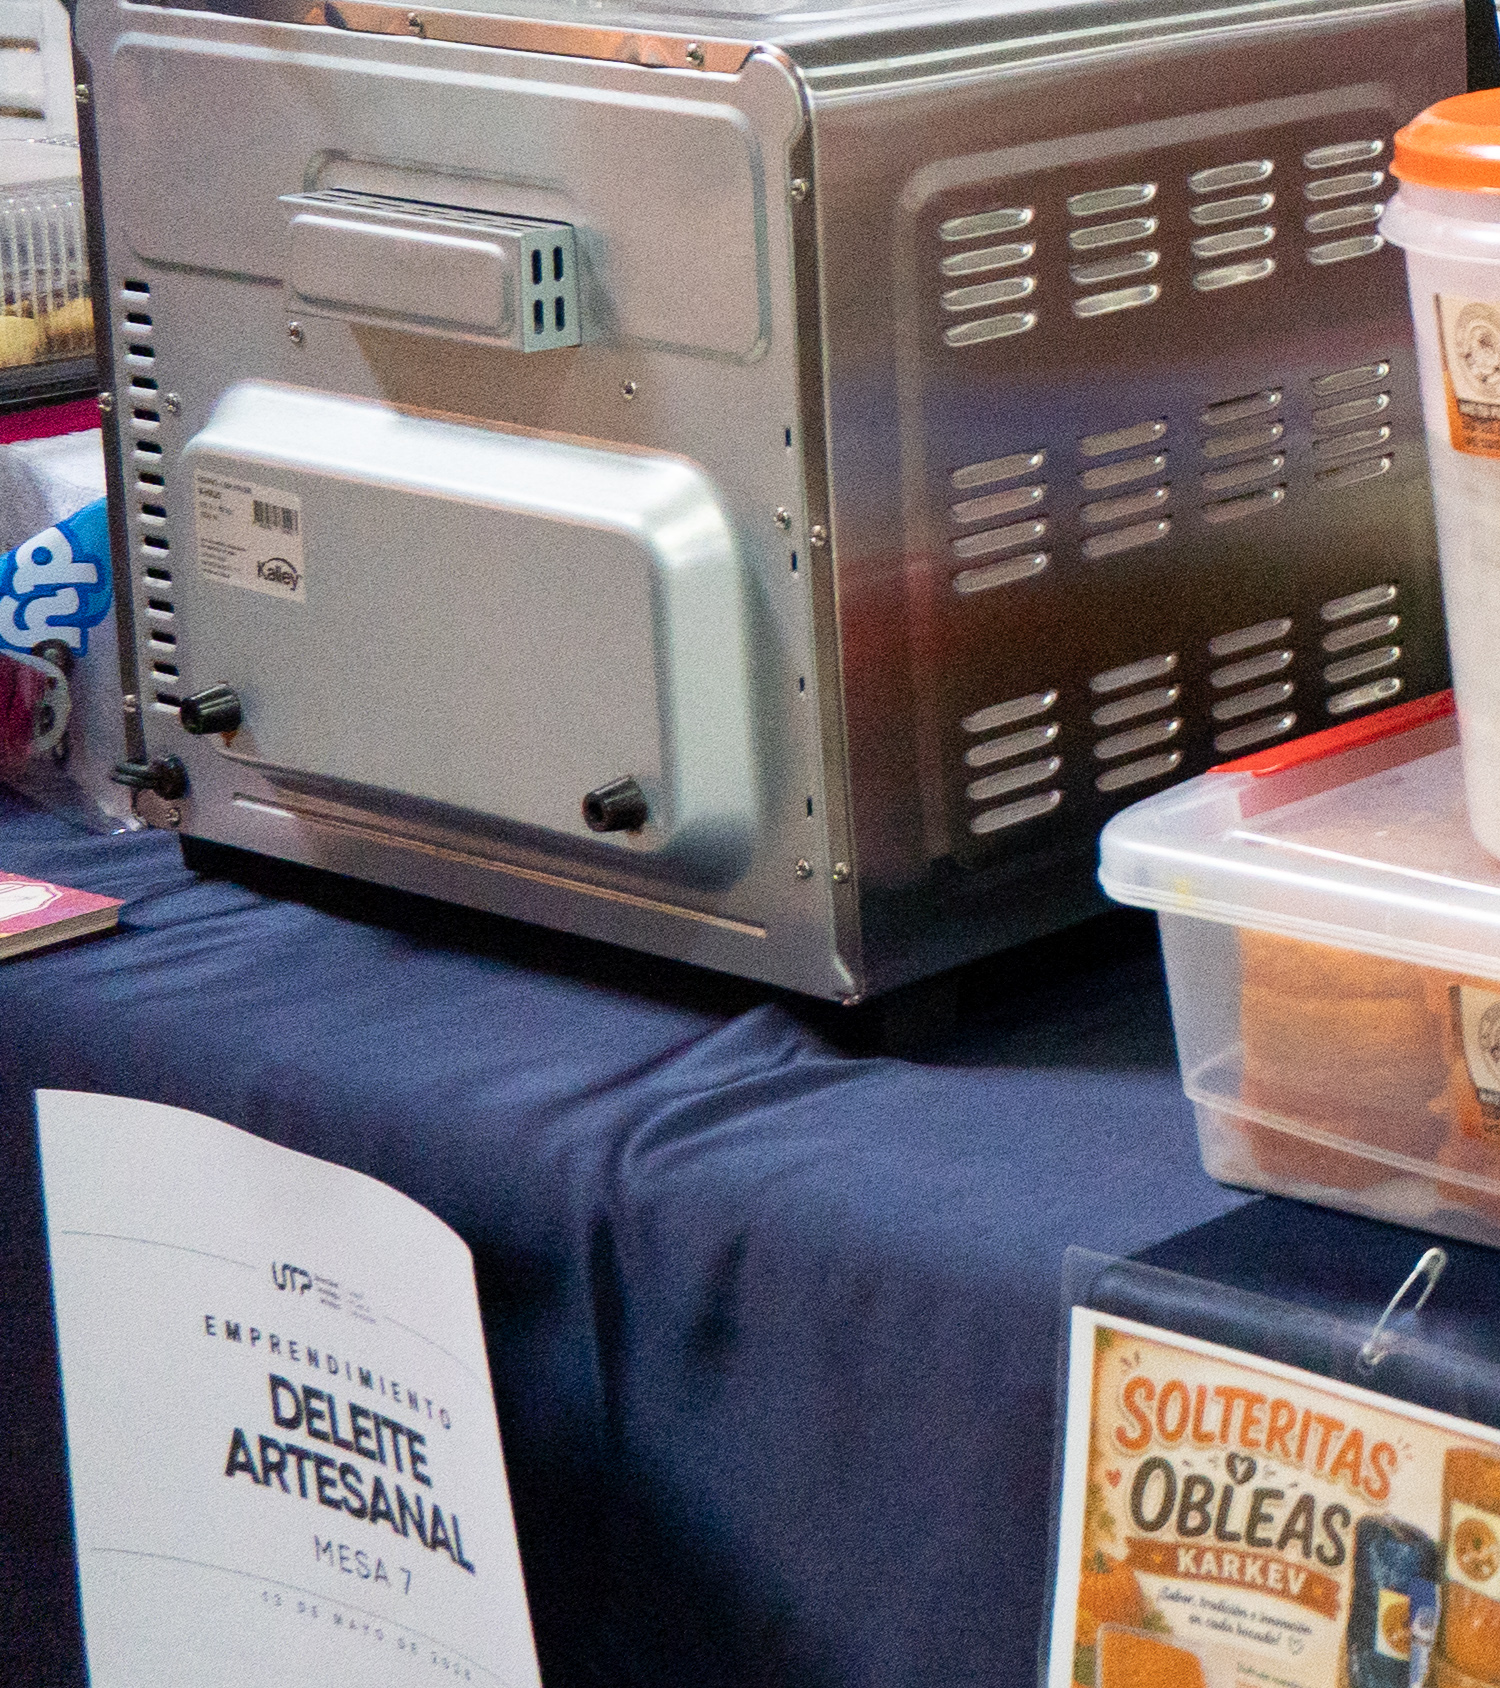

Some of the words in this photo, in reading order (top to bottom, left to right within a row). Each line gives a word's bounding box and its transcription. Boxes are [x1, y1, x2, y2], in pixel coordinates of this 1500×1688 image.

[204, 1315, 453, 1430] EMPRENDIMIENTO
[268, 1373, 434, 1488] DELEITE
[1115, 1376, 1398, 1500] SOLTERITAS
[224, 1427, 477, 1577] ARTESANAL
[1130, 1456, 1351, 1566] OBLEAS
[313, 1534, 391, 1588] MESA
[400, 1567, 411, 1595] 7
[1176, 1547, 1308, 1595] KARKEV
